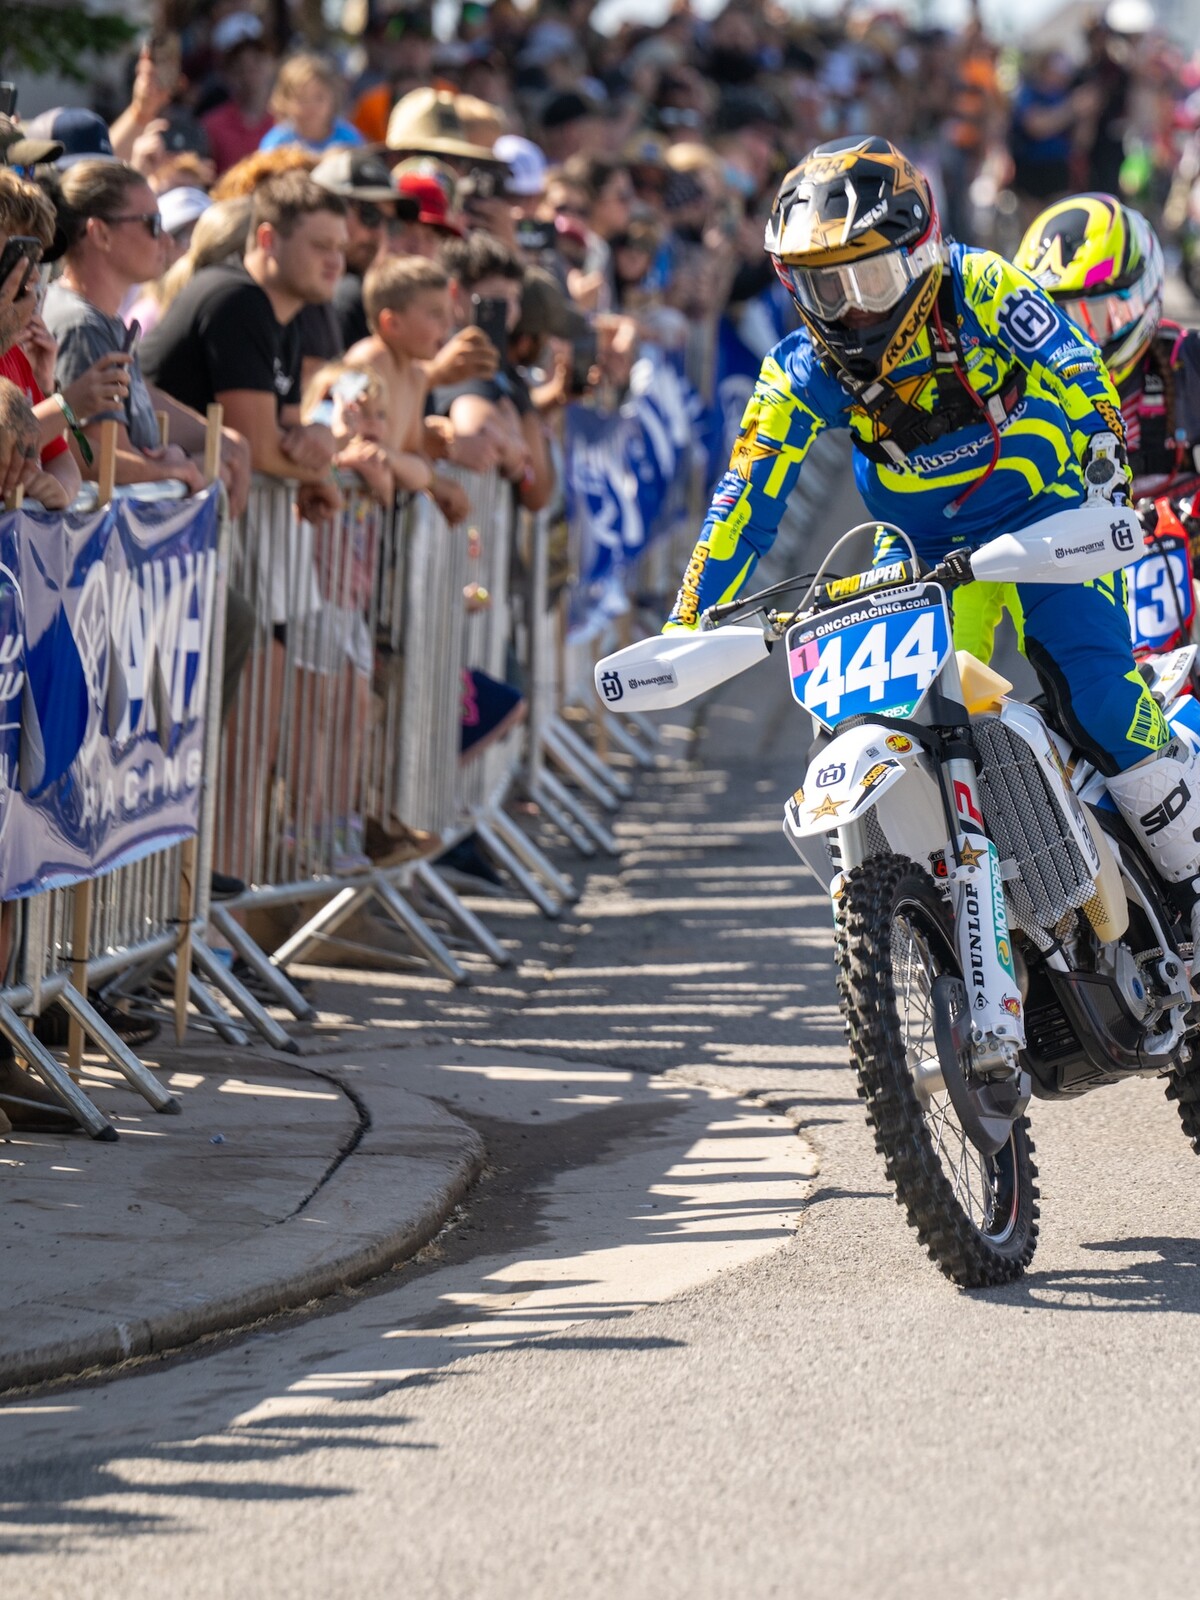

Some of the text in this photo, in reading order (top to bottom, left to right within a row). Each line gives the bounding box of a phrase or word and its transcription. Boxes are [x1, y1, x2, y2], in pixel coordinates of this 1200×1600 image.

[886, 269, 940, 366] ROCKSTA
[1046, 338, 1077, 364] TEAM
[1065, 540, 1104, 556] Husqvarna
[831, 564, 902, 598] PROTAPER
[816, 598, 931, 637] GNCCRACING.COM
[798, 649, 809, 673] 1
[804, 611, 938, 718] 444
[637, 674, 673, 687] Husqvarna
[992, 855, 1008, 940] MOTOREX
[965, 882, 985, 988] DUNLOP
